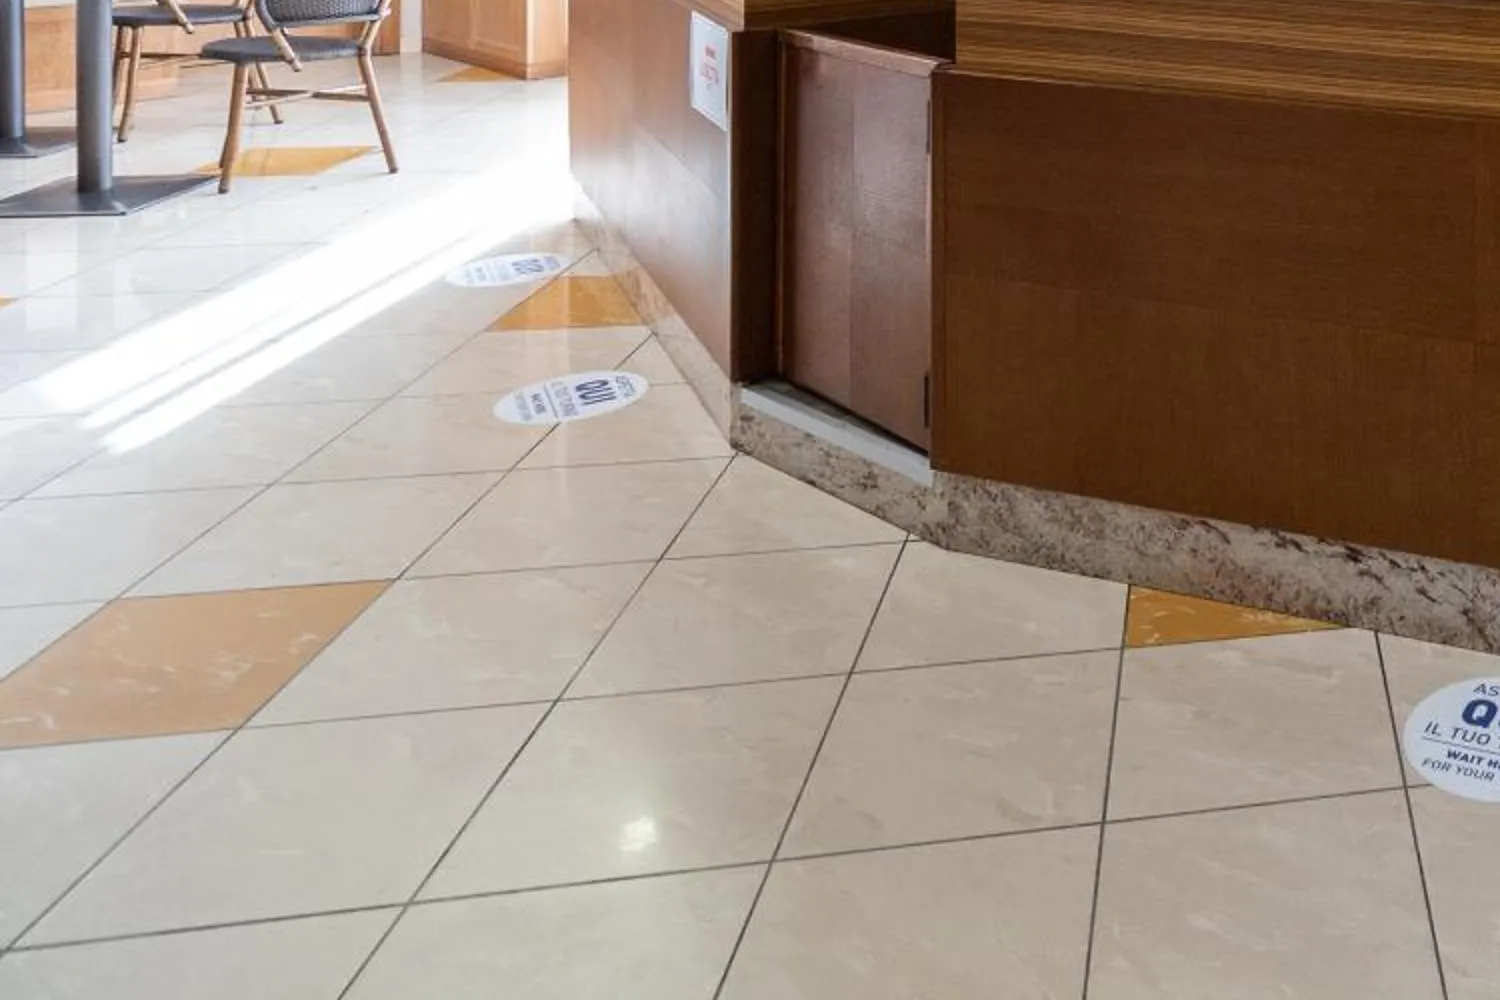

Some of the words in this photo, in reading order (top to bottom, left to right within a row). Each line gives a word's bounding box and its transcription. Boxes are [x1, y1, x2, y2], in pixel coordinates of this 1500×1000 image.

[1424, 721, 1442, 736] IL
[1451, 727, 1491, 746] TUO
[1446, 749, 1485, 766] WAIT
[1421, 758, 1451, 772] FOR
[1455, 766, 1495, 782] YOUR
